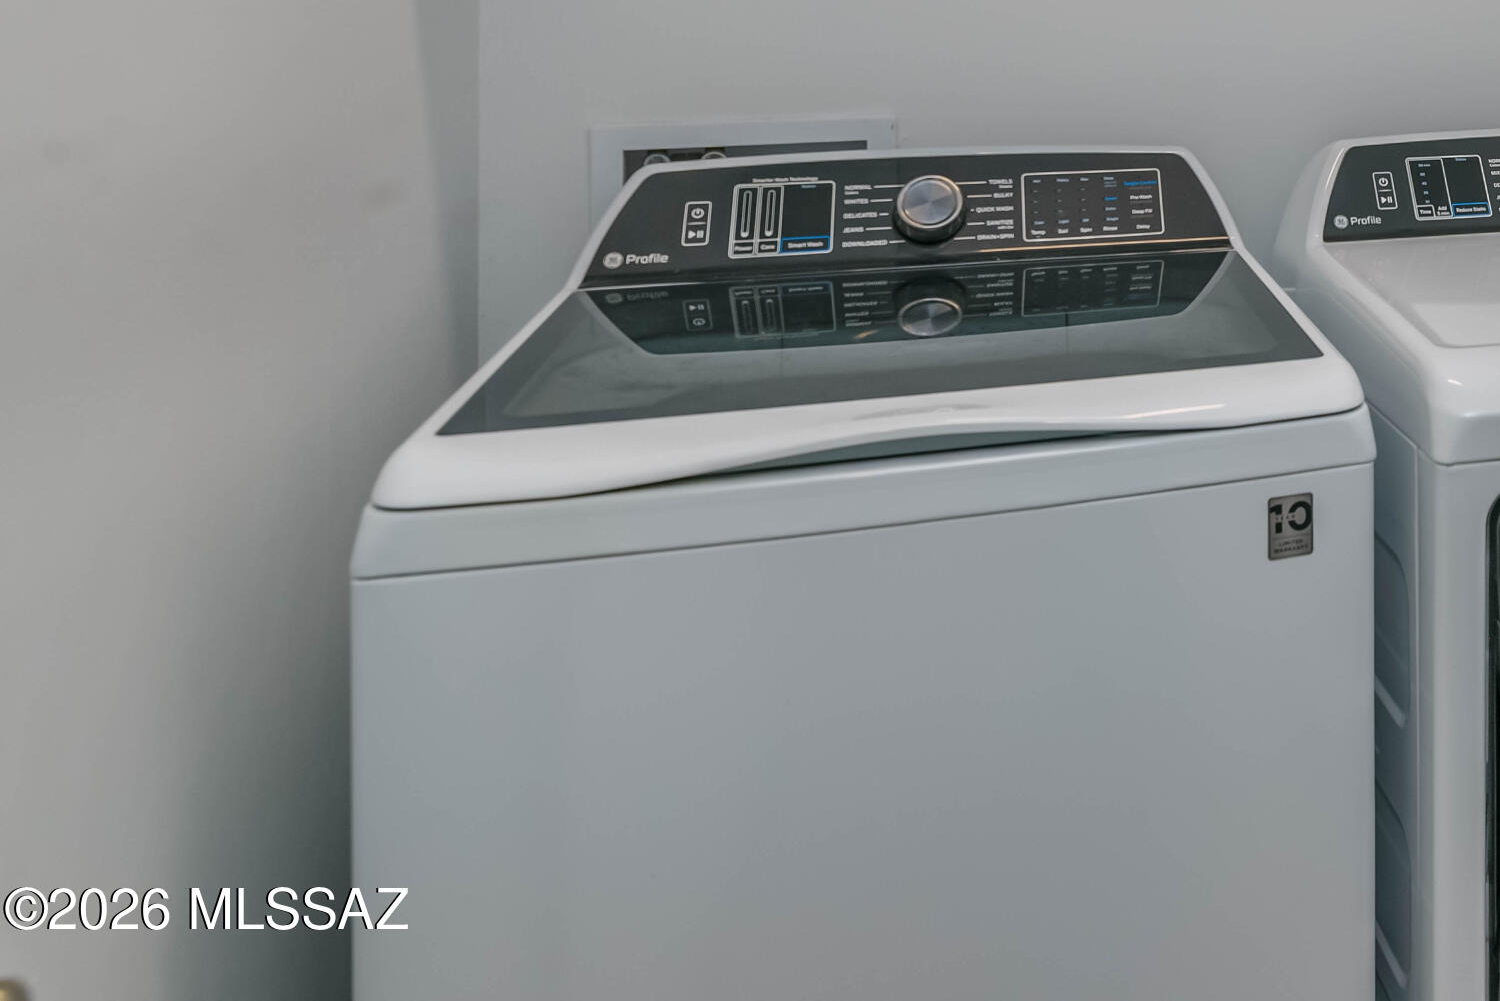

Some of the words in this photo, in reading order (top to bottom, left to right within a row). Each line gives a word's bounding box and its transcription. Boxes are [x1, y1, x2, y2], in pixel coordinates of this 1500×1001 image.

[1351, 216, 1382, 226] Profile
[843, 226, 864, 234] JEANS
[841, 239, 888, 248] DOWNLOADED
[625, 253, 669, 266] Profile
[1269, 500, 1313, 535] 10
